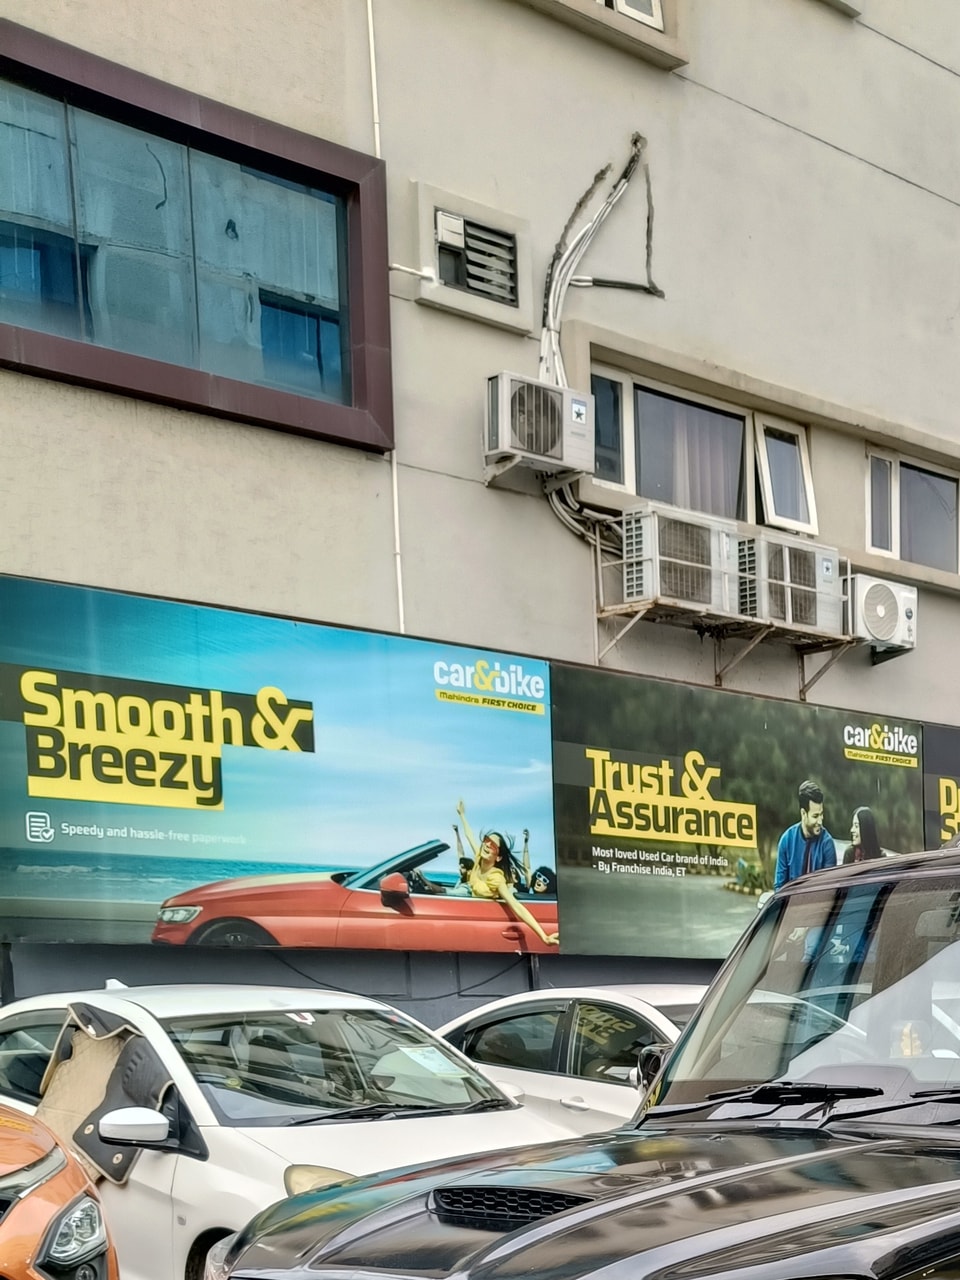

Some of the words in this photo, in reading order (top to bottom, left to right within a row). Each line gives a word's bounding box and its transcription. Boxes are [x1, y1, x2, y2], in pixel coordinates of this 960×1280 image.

[433, 660, 545, 698] car&bike
[20, 670, 244, 746] Smooth
[251, 686, 314, 752] &
[439, 691, 480, 704] Mahindra
[481, 697, 506, 708] FIRST
[507, 701, 537, 712] CHOICE
[843, 723, 918, 754] car&bike
[27, 726, 223, 806] Breezy
[586, 748, 675, 797] Trust
[681, 750, 721, 801] &
[590, 789, 754, 841] Assurance
[61, 823, 104, 838] Speedy
[107, 827, 128, 838] and
[130, 828, 190, 842] hassle-free
[592, 846, 614, 858] Most
[615, 848, 638, 860] loved
[639, 850, 660, 862] Used
[660, 852, 675, 863] Car
[675, 853, 699, 865] brand
[699, 855, 709, 865] of
[709, 856, 729, 867] India
[598, 861, 610, 874] By
[611, 862, 652, 875] Franchise
[652, 865, 675, 878] India,
[676, 867, 687, 877] ET
